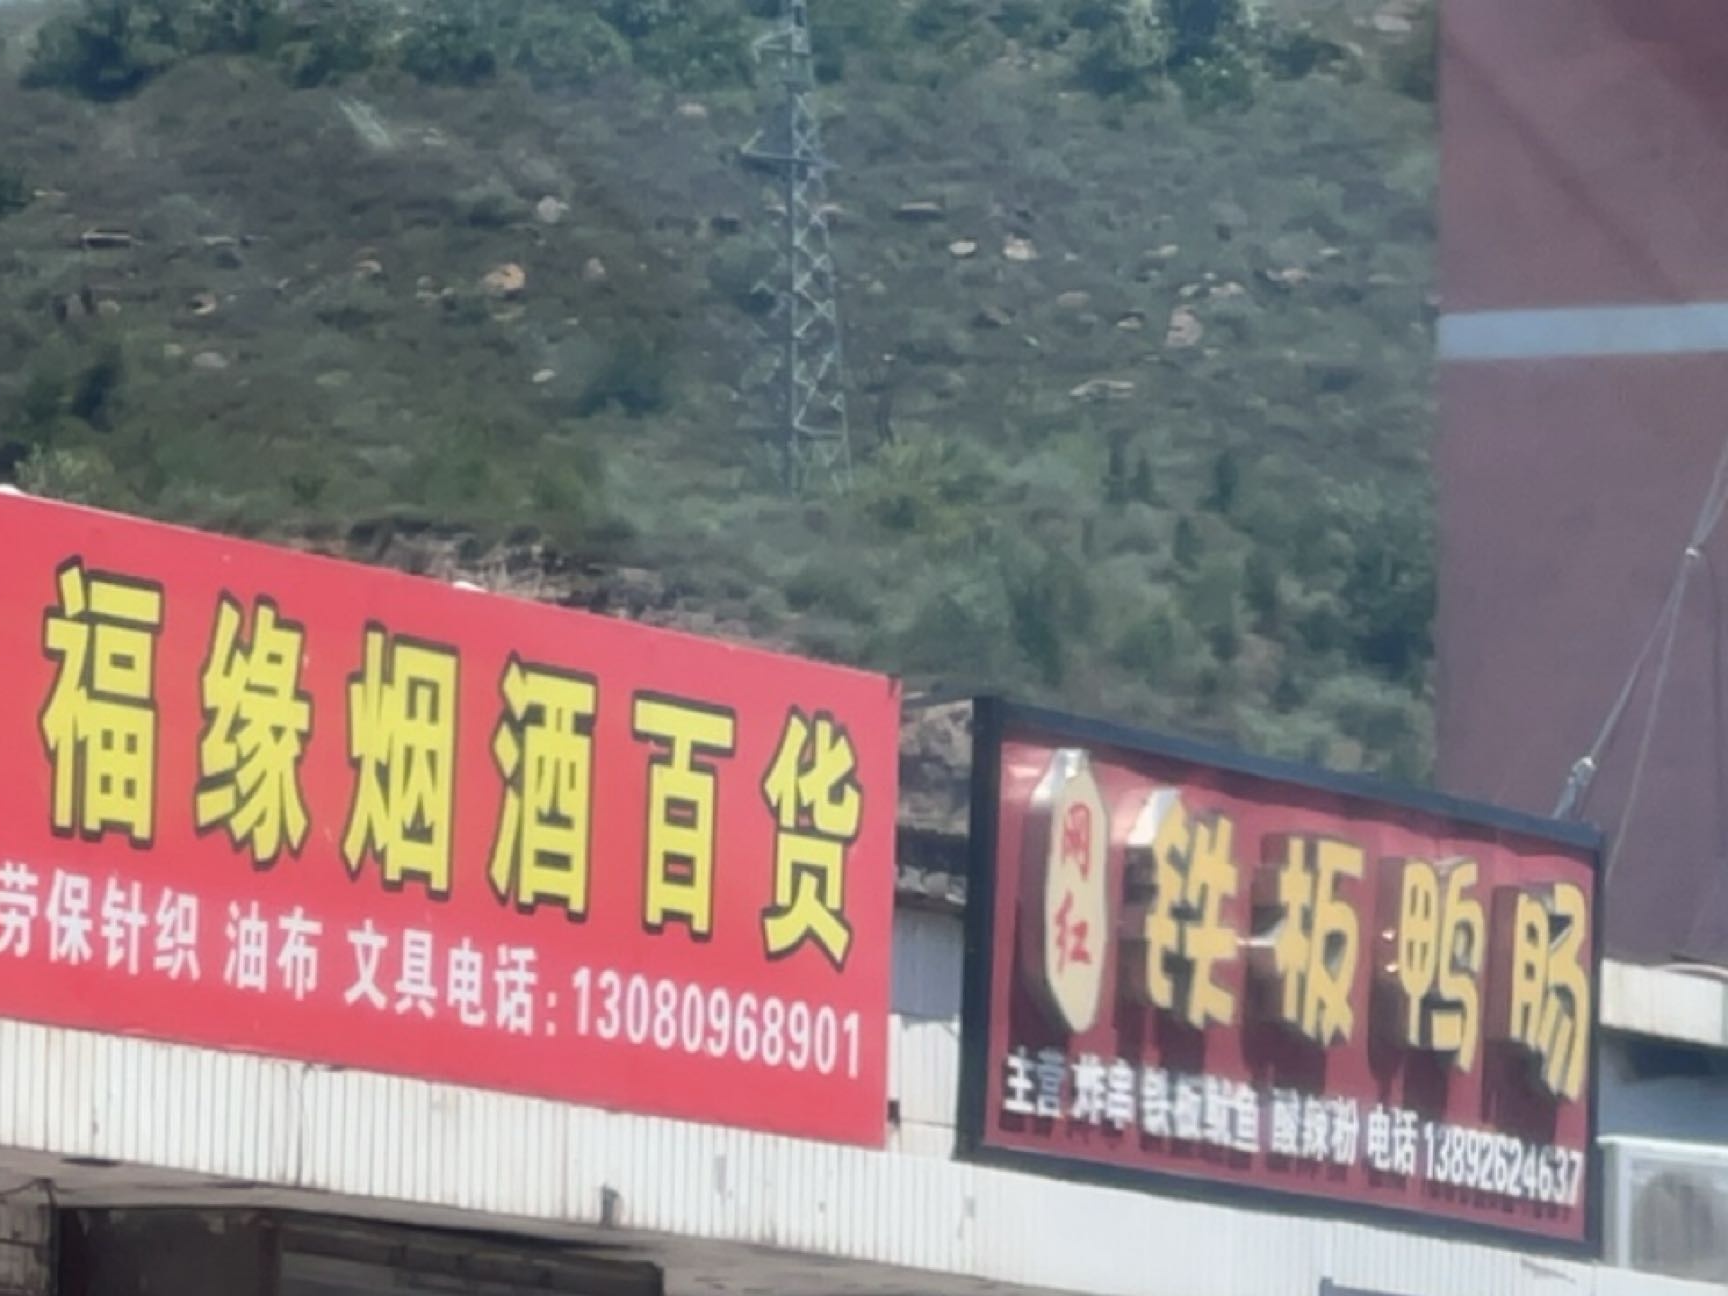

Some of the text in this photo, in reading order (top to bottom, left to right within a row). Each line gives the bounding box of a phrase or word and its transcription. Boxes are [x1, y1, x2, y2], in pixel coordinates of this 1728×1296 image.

[38, 556, 862, 971] 福缘烟酒百货
[224, 900, 322, 1001] 油布
[1145, 792, 1590, 1102] 铁板鸭肠
[1004, 1045, 1065, 1118] 主营
[1071, 1052, 1134, 1130] 炸串
[1367, 1103, 1419, 1176] 电话
